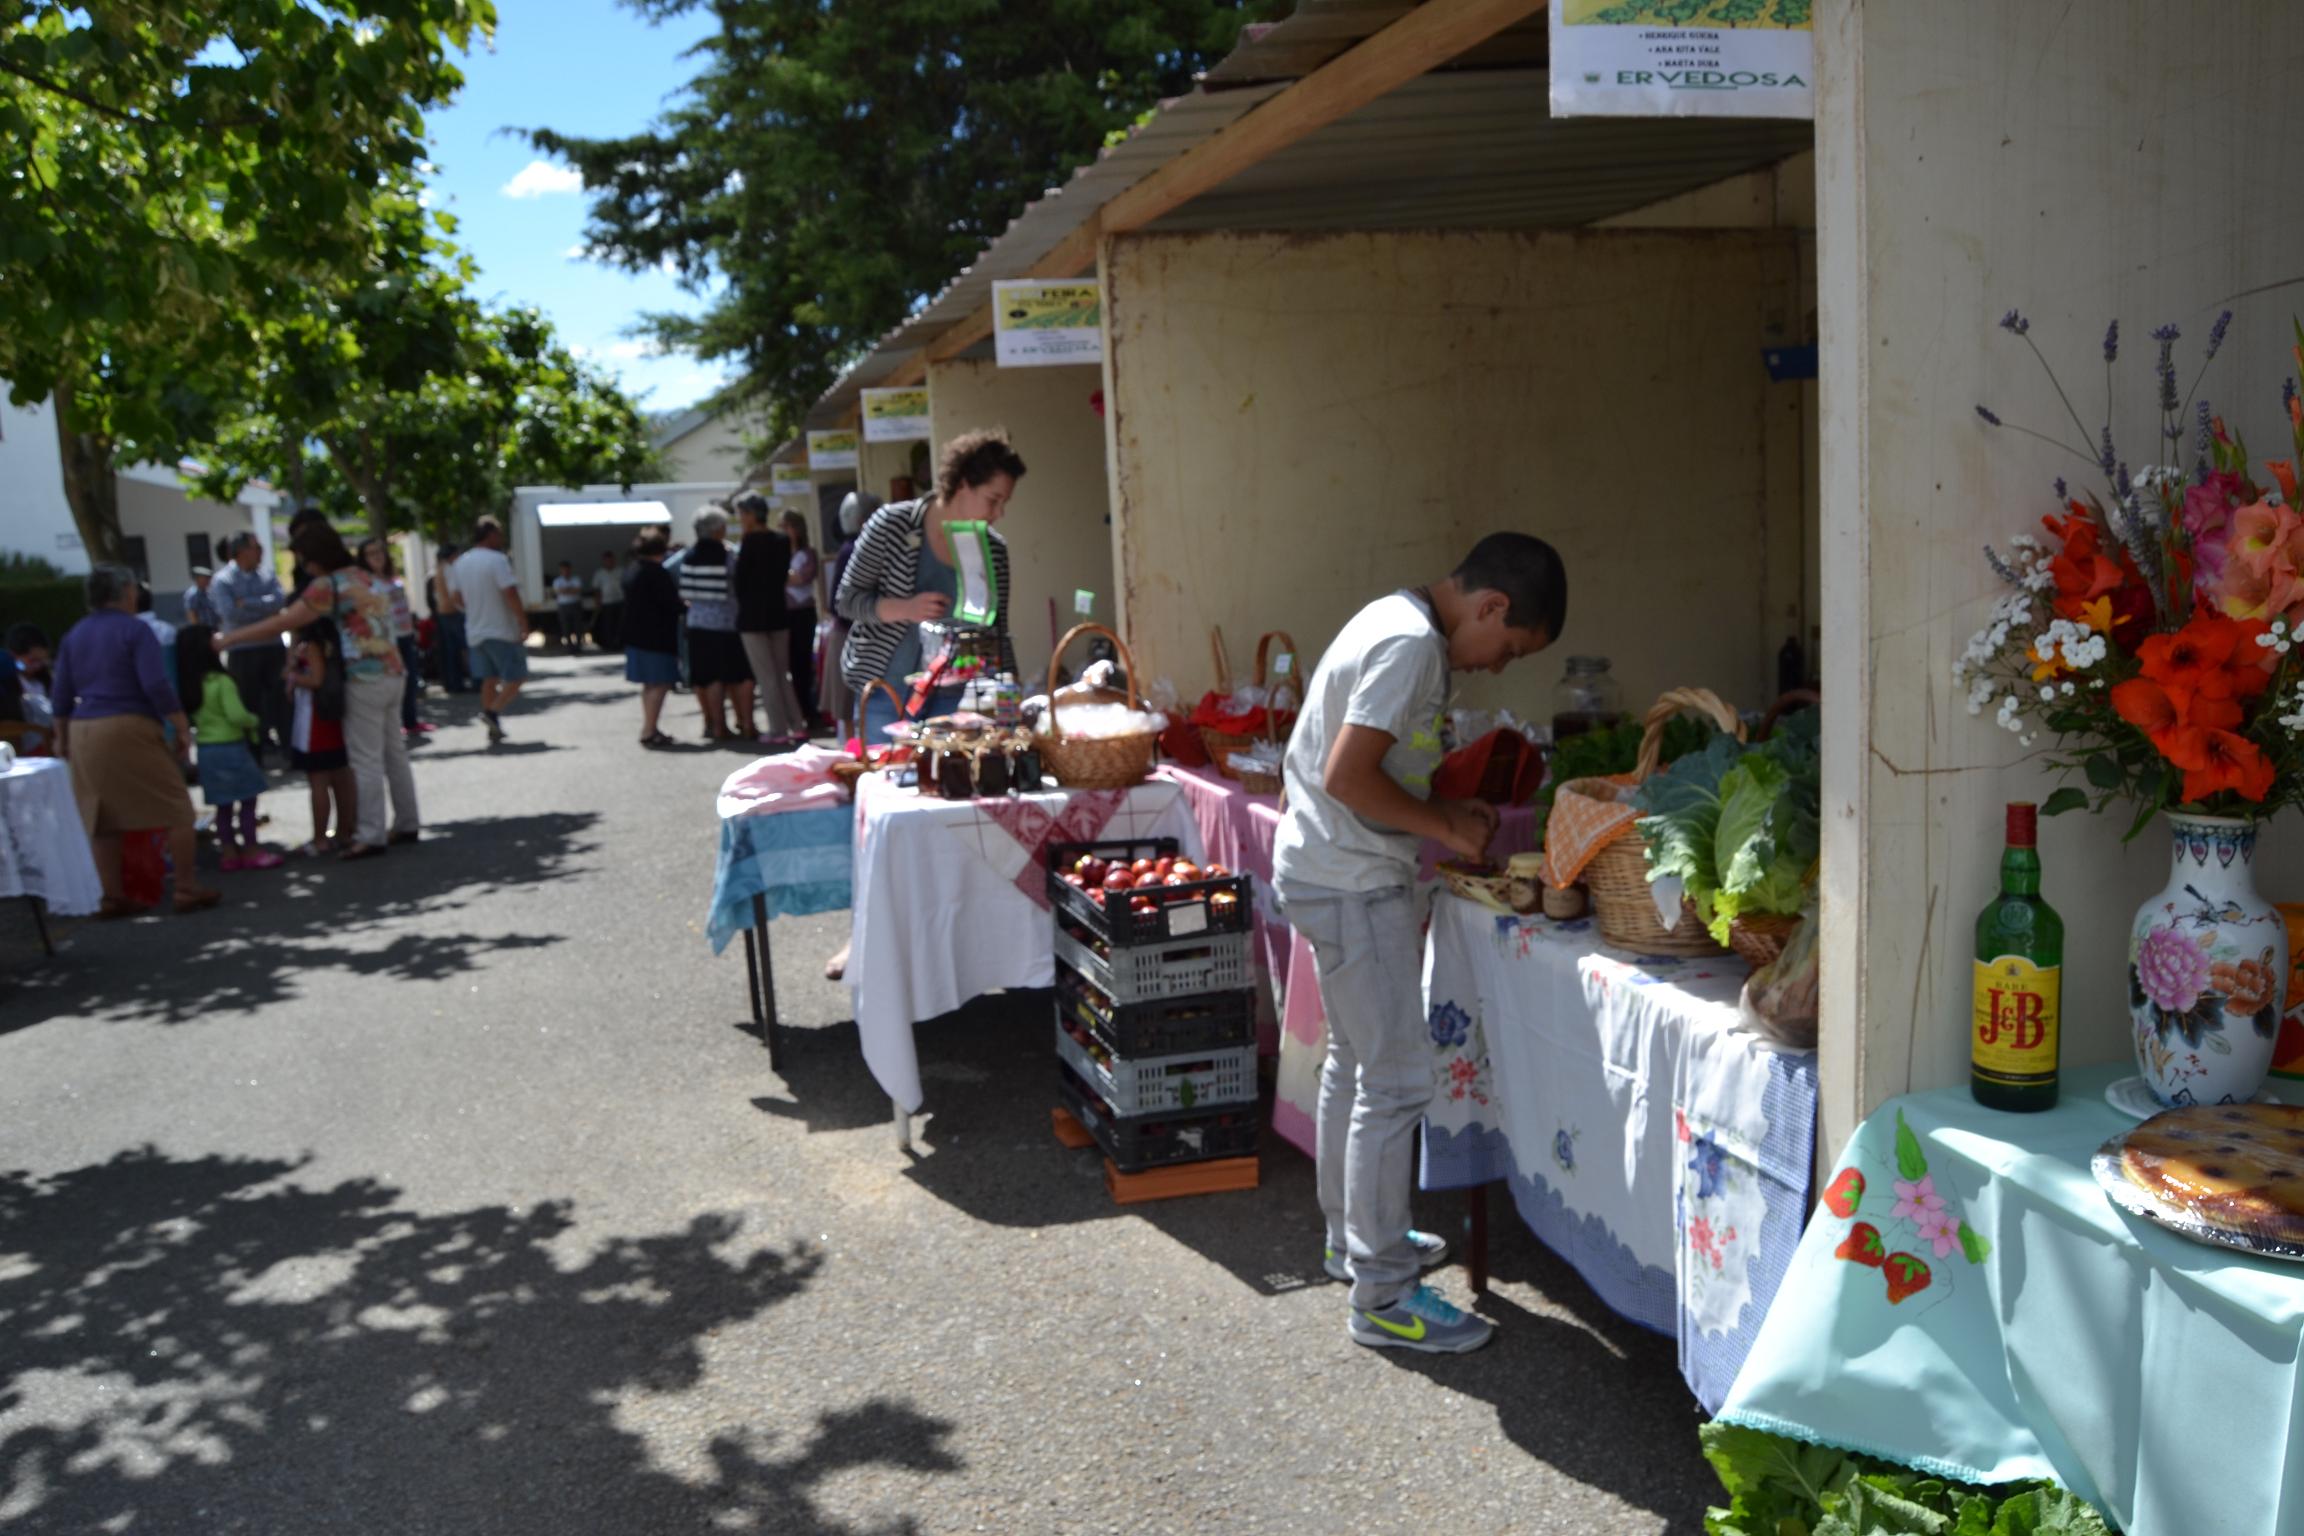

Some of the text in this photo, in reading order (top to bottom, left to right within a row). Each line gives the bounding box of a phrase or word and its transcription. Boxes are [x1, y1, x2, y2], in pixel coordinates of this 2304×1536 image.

[1664, 58, 1695, 67] MARTA
[1616, 70, 1806, 87] ERVEDOSA
[1979, 988, 2045, 1050] J&B
